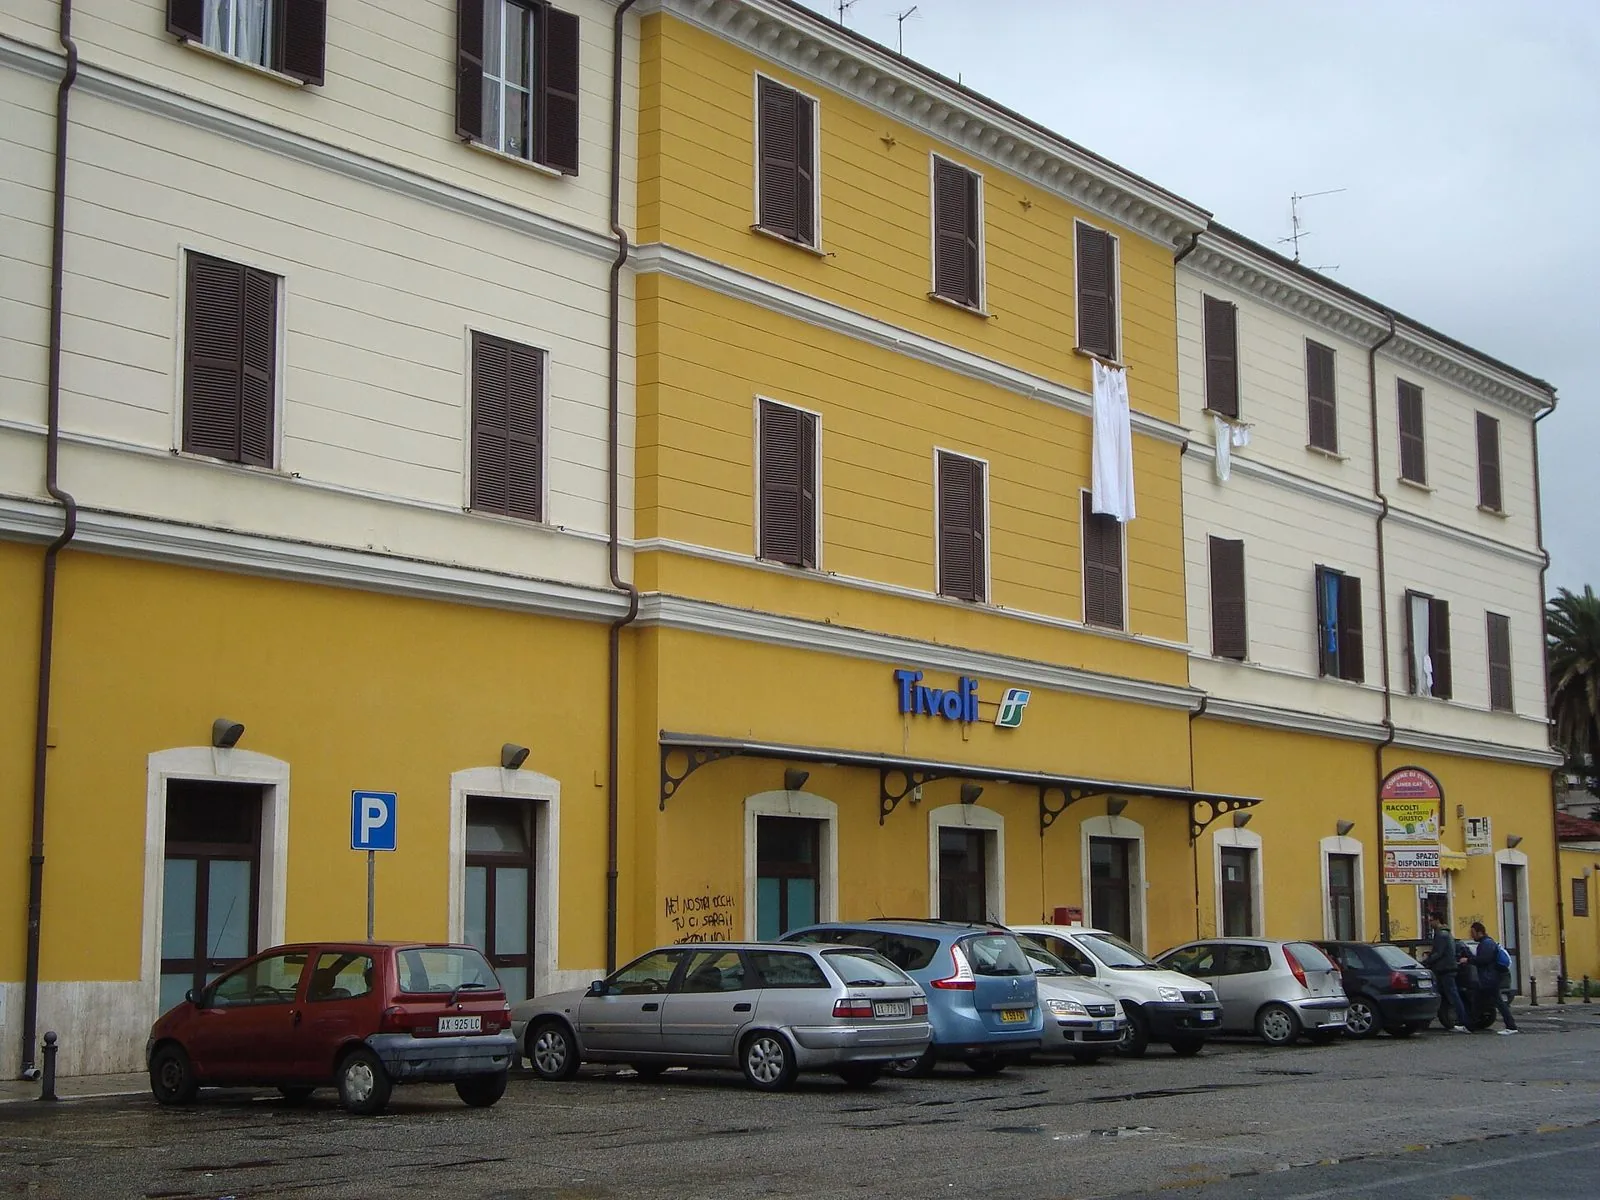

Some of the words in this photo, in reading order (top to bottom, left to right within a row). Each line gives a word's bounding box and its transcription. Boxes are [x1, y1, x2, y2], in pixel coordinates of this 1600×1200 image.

[894, 669, 979, 722] Tivoli
[1386, 772, 1408, 790] COMUNE
[1417, 773, 1434, 789] TIVOLI
[361, 797, 388, 843] P
[1468, 818, 1481, 837] T
[1415, 852, 1439, 860] SPAZIO
